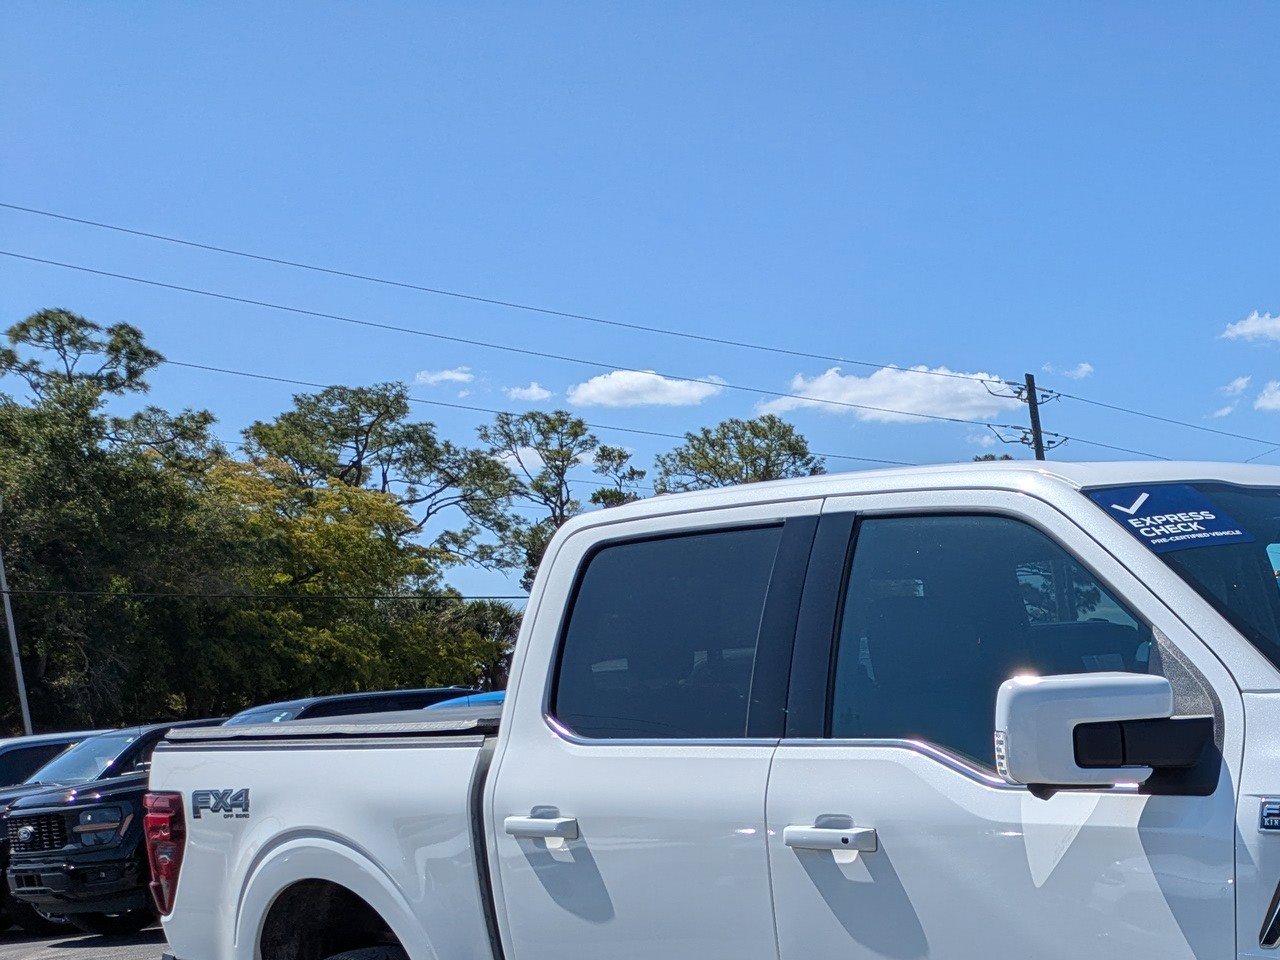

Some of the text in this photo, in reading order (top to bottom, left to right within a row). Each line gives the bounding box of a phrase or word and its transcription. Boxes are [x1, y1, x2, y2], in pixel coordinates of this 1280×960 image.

[1127, 510, 1216, 528] EXPRESS
[1140, 521, 1206, 537] CHECK
[1151, 529, 1243, 545] PRE-CERTIFIED VEHICLE
[192, 788, 250, 819] FX4
